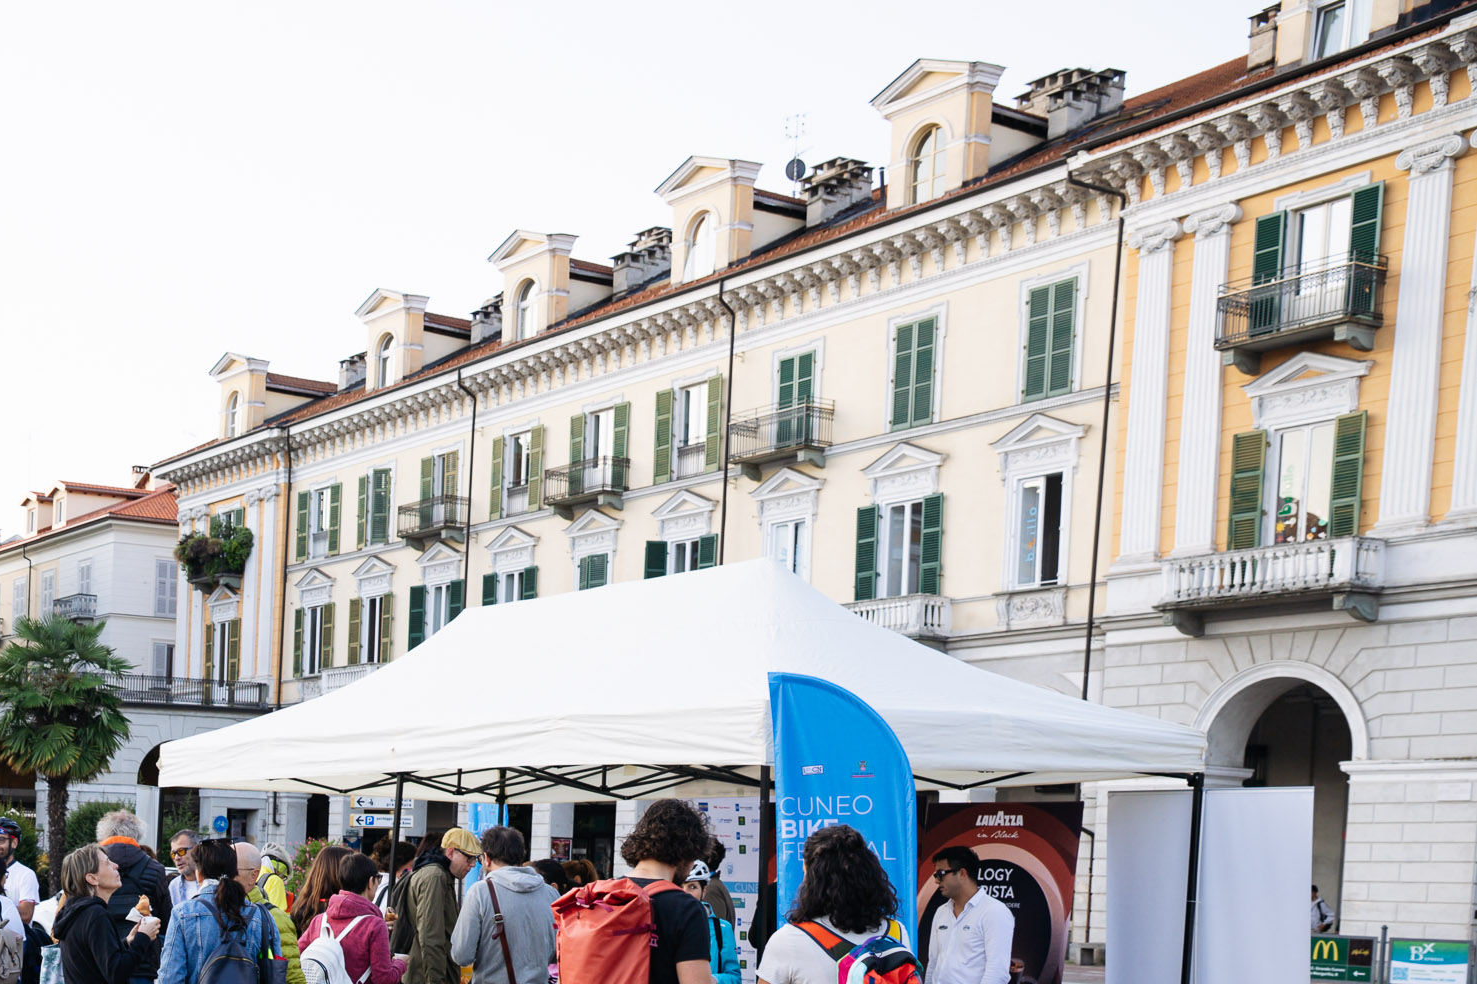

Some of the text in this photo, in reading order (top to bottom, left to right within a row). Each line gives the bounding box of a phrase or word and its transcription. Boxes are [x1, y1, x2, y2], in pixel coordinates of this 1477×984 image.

[780, 795, 873, 816] CUNEO
[976, 811, 1023, 826] LAVAZZA
[783, 841, 897, 861] FEAL
